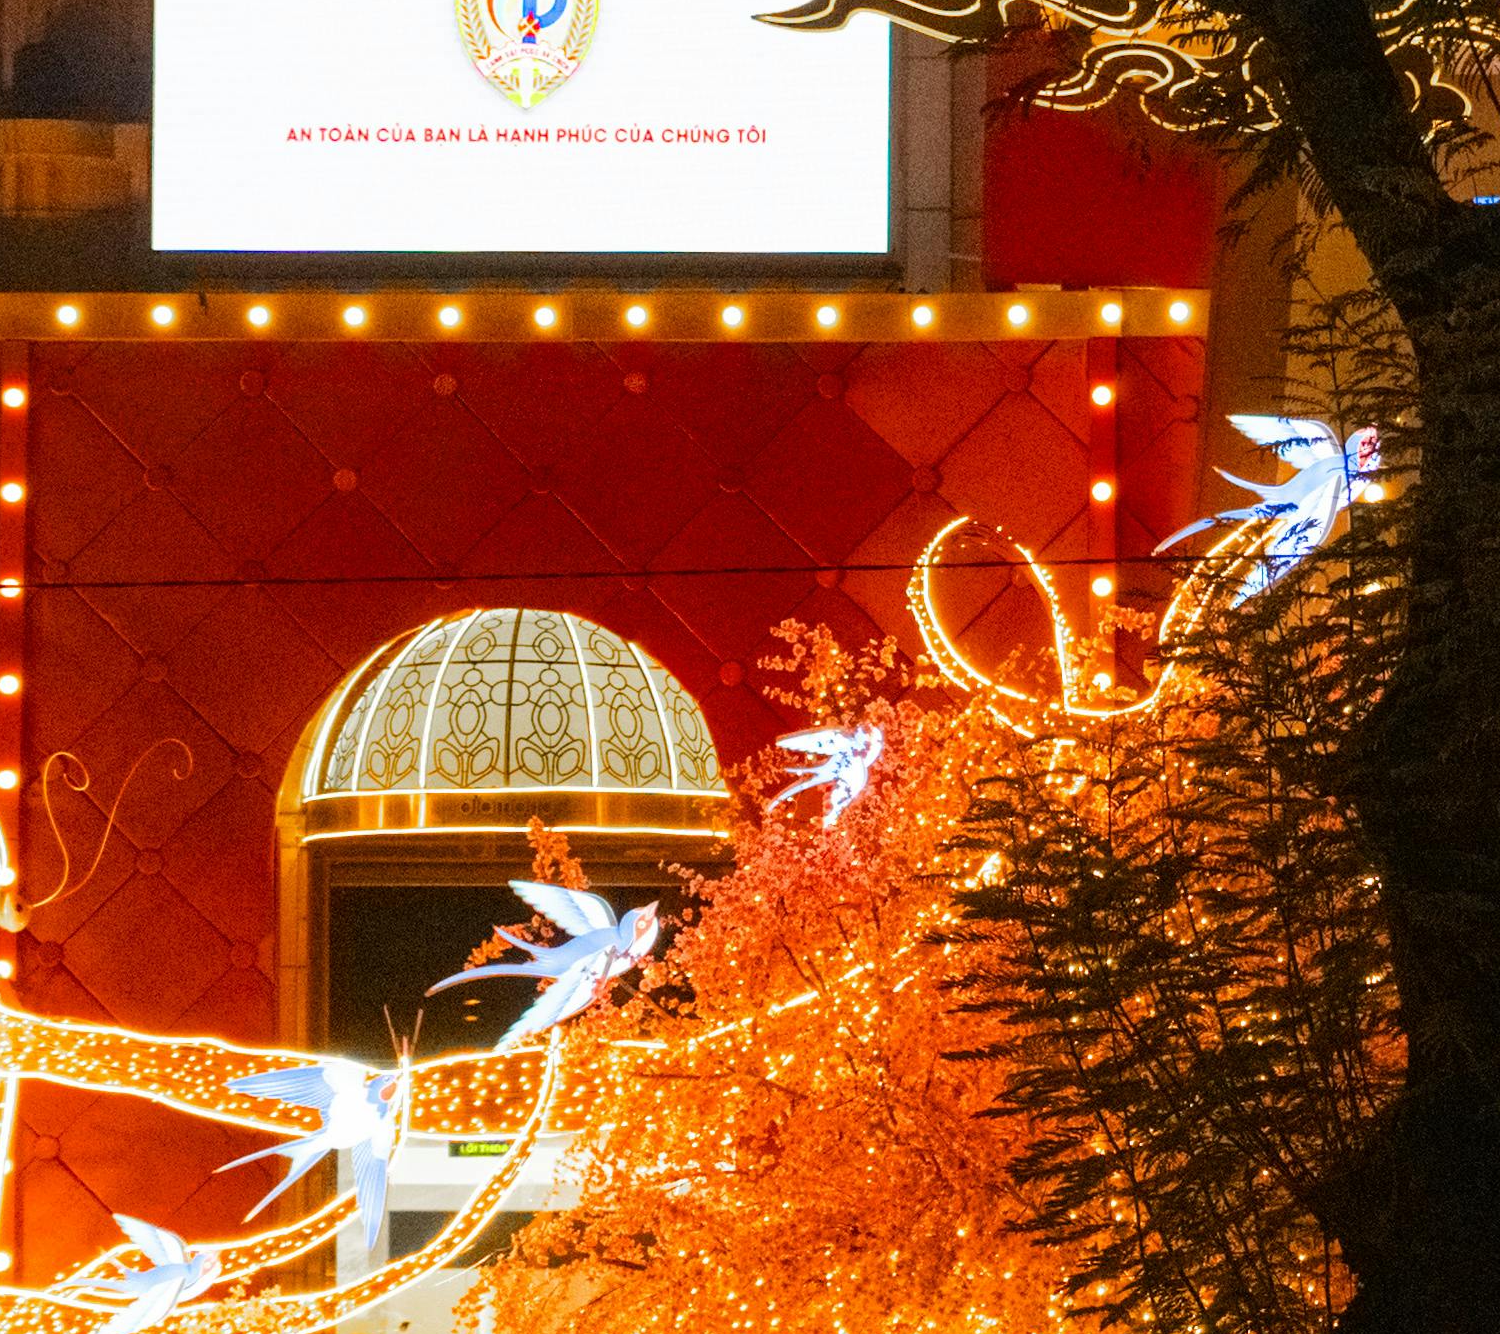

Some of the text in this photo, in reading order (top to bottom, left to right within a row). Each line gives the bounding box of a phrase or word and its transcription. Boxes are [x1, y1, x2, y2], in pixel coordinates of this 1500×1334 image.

[286, 127, 312, 143] AN
[319, 123, 370, 143] TOÀN
[376, 123, 416, 143] CỦA
[468, 123, 489, 143] LÀ
[556, 123, 607, 143] PHÚC
[614, 123, 654, 143] CỦA
[661, 123, 730, 143] CHÚNG
[737, 123, 767, 143] TÔI
